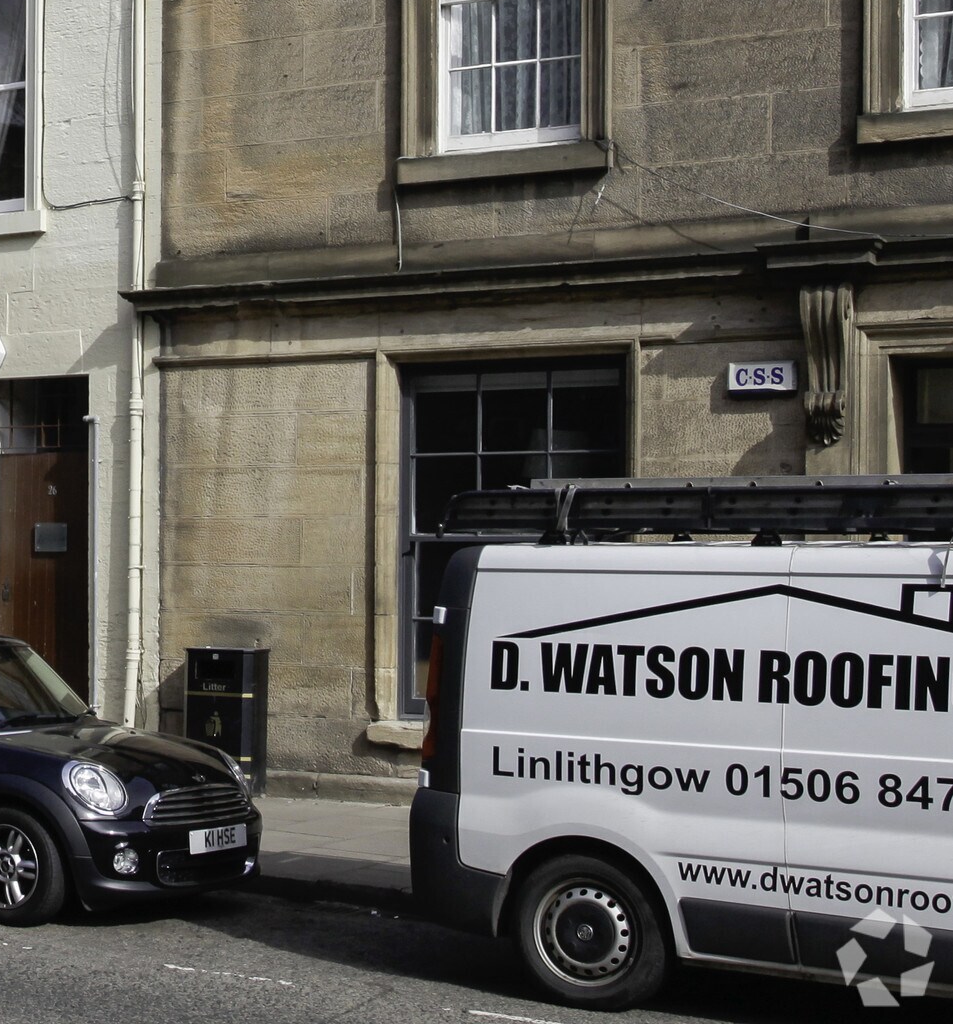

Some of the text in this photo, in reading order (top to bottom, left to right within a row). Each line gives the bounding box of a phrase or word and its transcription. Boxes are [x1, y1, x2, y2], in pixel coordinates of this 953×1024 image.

[48, 485, 57, 495] 26
[202, 682, 226, 691] Litter
[490, 640, 951, 712] D. WATSON ROOFIN
[492, 745, 953, 812] Linlithgow 01506 847
[218, 827, 236, 845] HSE
[677, 861, 952, 914] www.dwatsonroo
